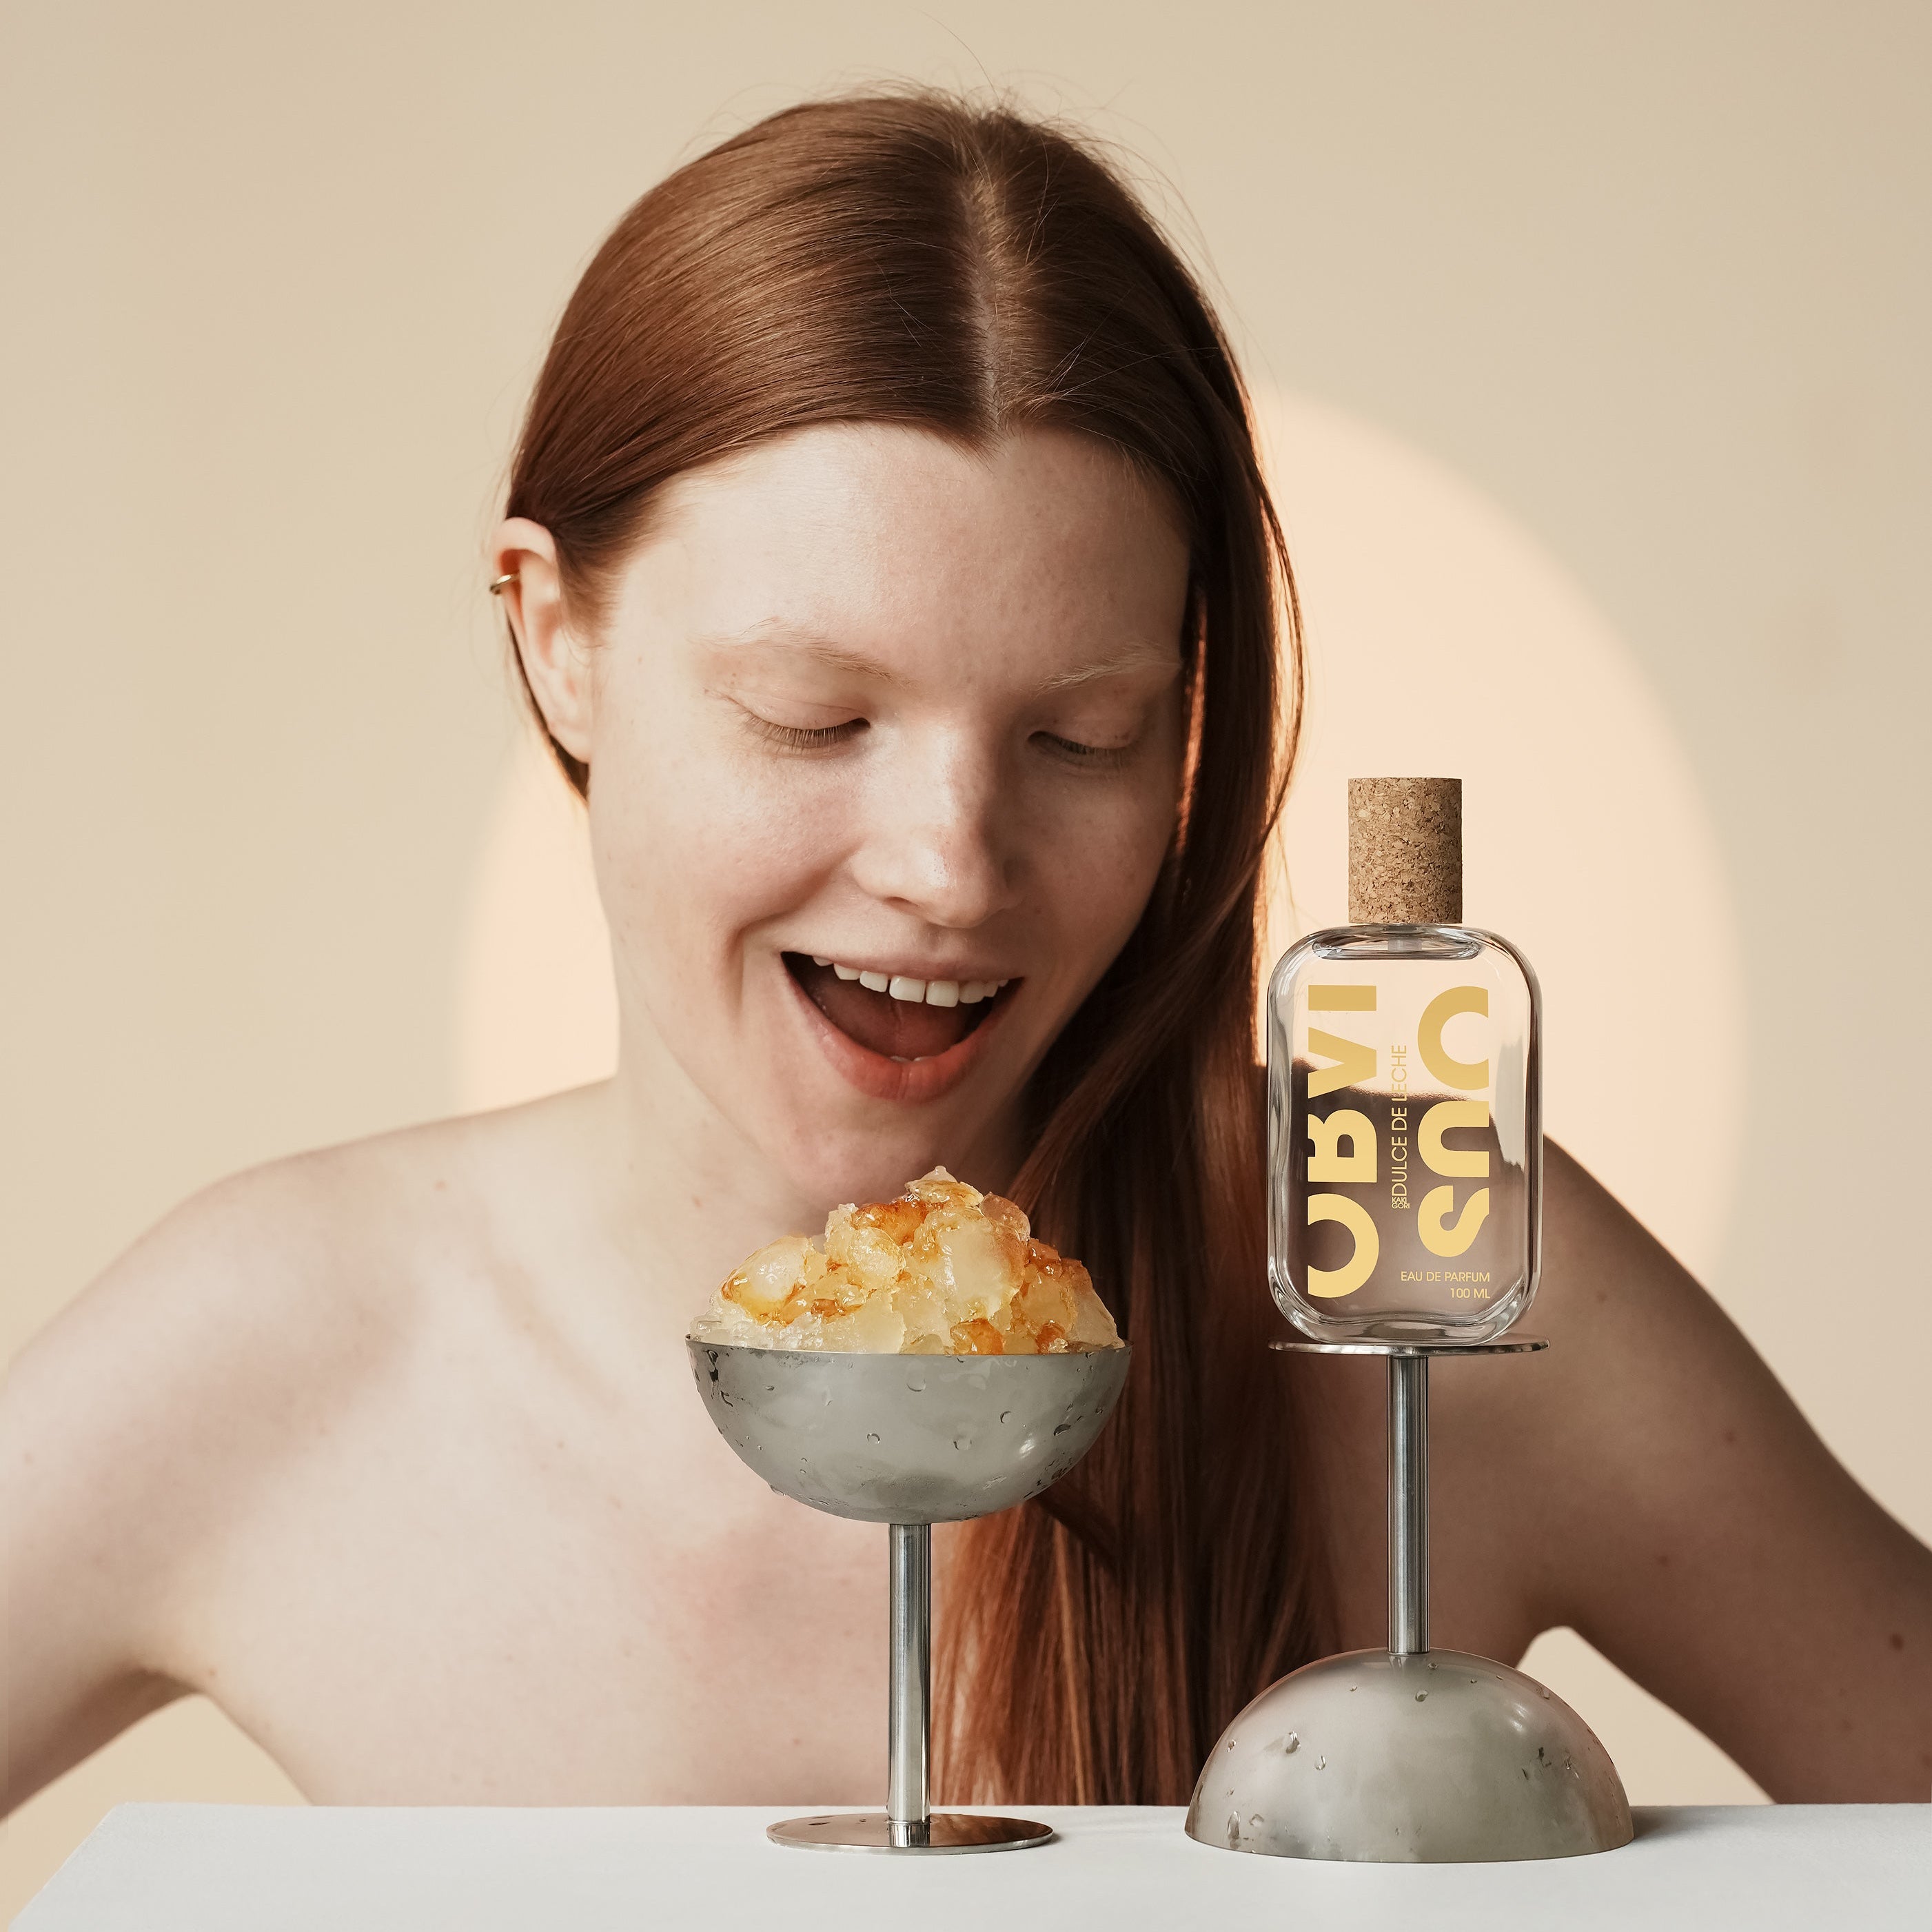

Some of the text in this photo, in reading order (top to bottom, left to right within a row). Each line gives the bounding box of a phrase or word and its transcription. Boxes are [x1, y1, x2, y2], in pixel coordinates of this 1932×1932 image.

[1391, 1045, 1407, 1197] DULCE DE LECHE
[1401, 1271, 1490, 1283] EAU DE PARFUM
[1450, 1288, 1491, 1299] 100 ML
